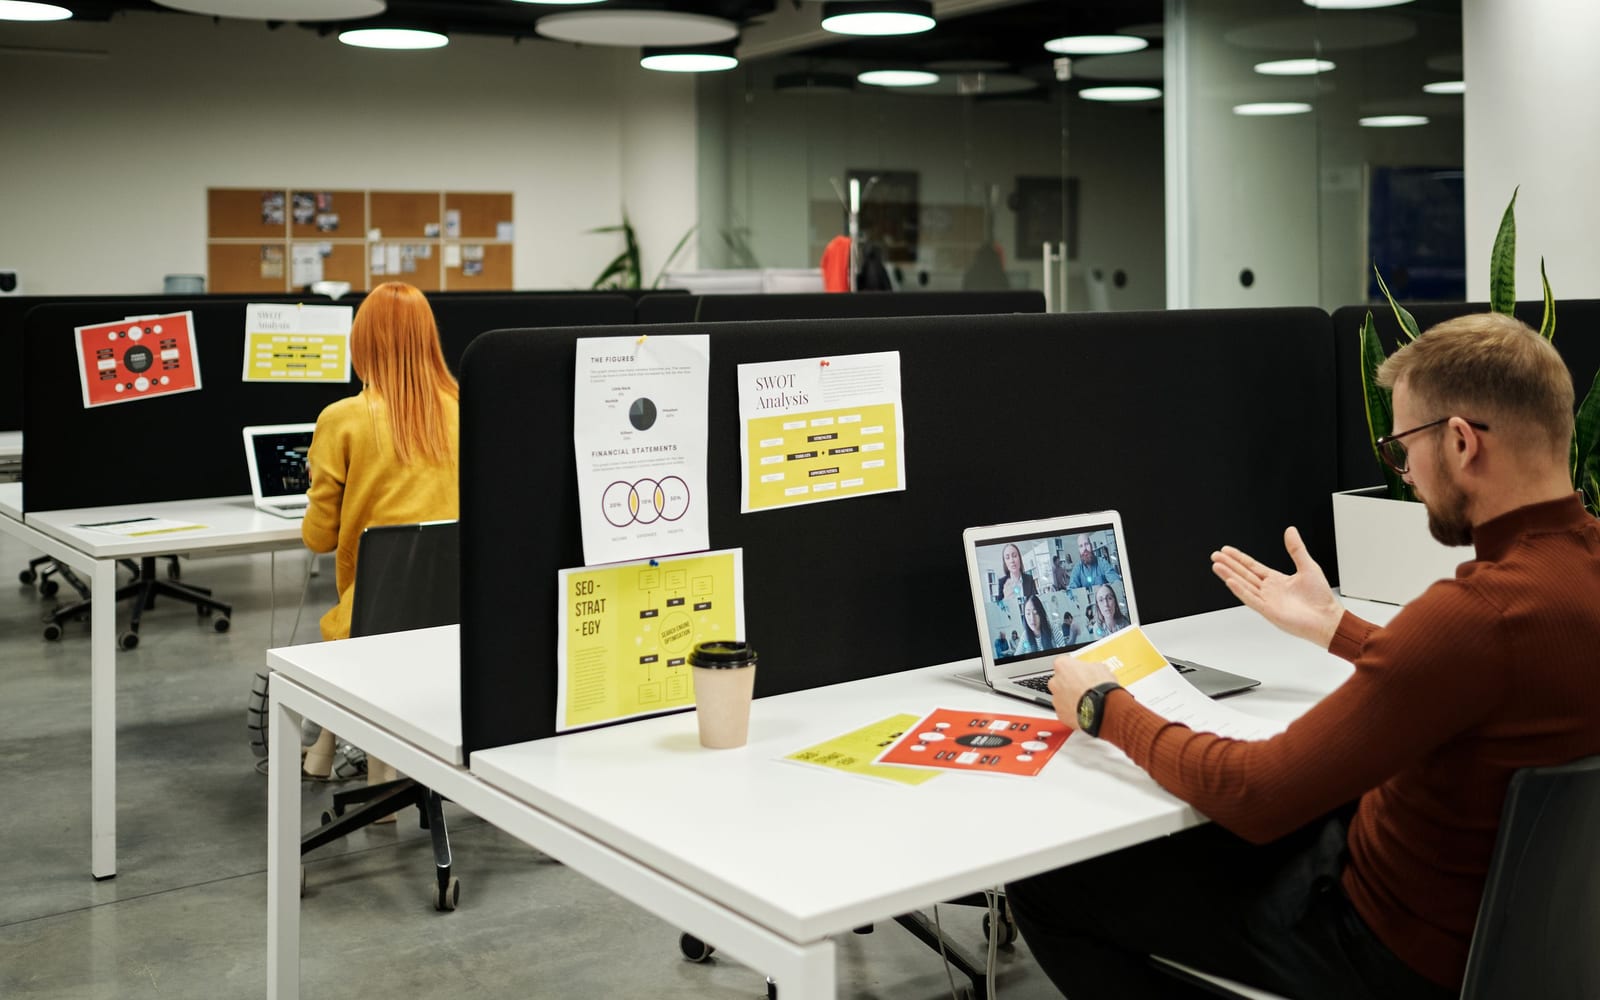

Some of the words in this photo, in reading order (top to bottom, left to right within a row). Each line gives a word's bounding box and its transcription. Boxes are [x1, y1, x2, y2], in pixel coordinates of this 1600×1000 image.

[606, 355, 634, 363] FIGURES
[756, 373, 796, 391] SWOT
[756, 390, 809, 410] Analysis
[592, 448, 629, 457] FINANCIAL
[632, 444, 678, 454] STATEMENTS
[575, 580, 594, 596] SEO
[575, 598, 606, 617] STRAT
[582, 619, 601, 636] EGY
[661, 627, 676, 639] SEARCH
[677, 620, 690, 632] ENGINE
